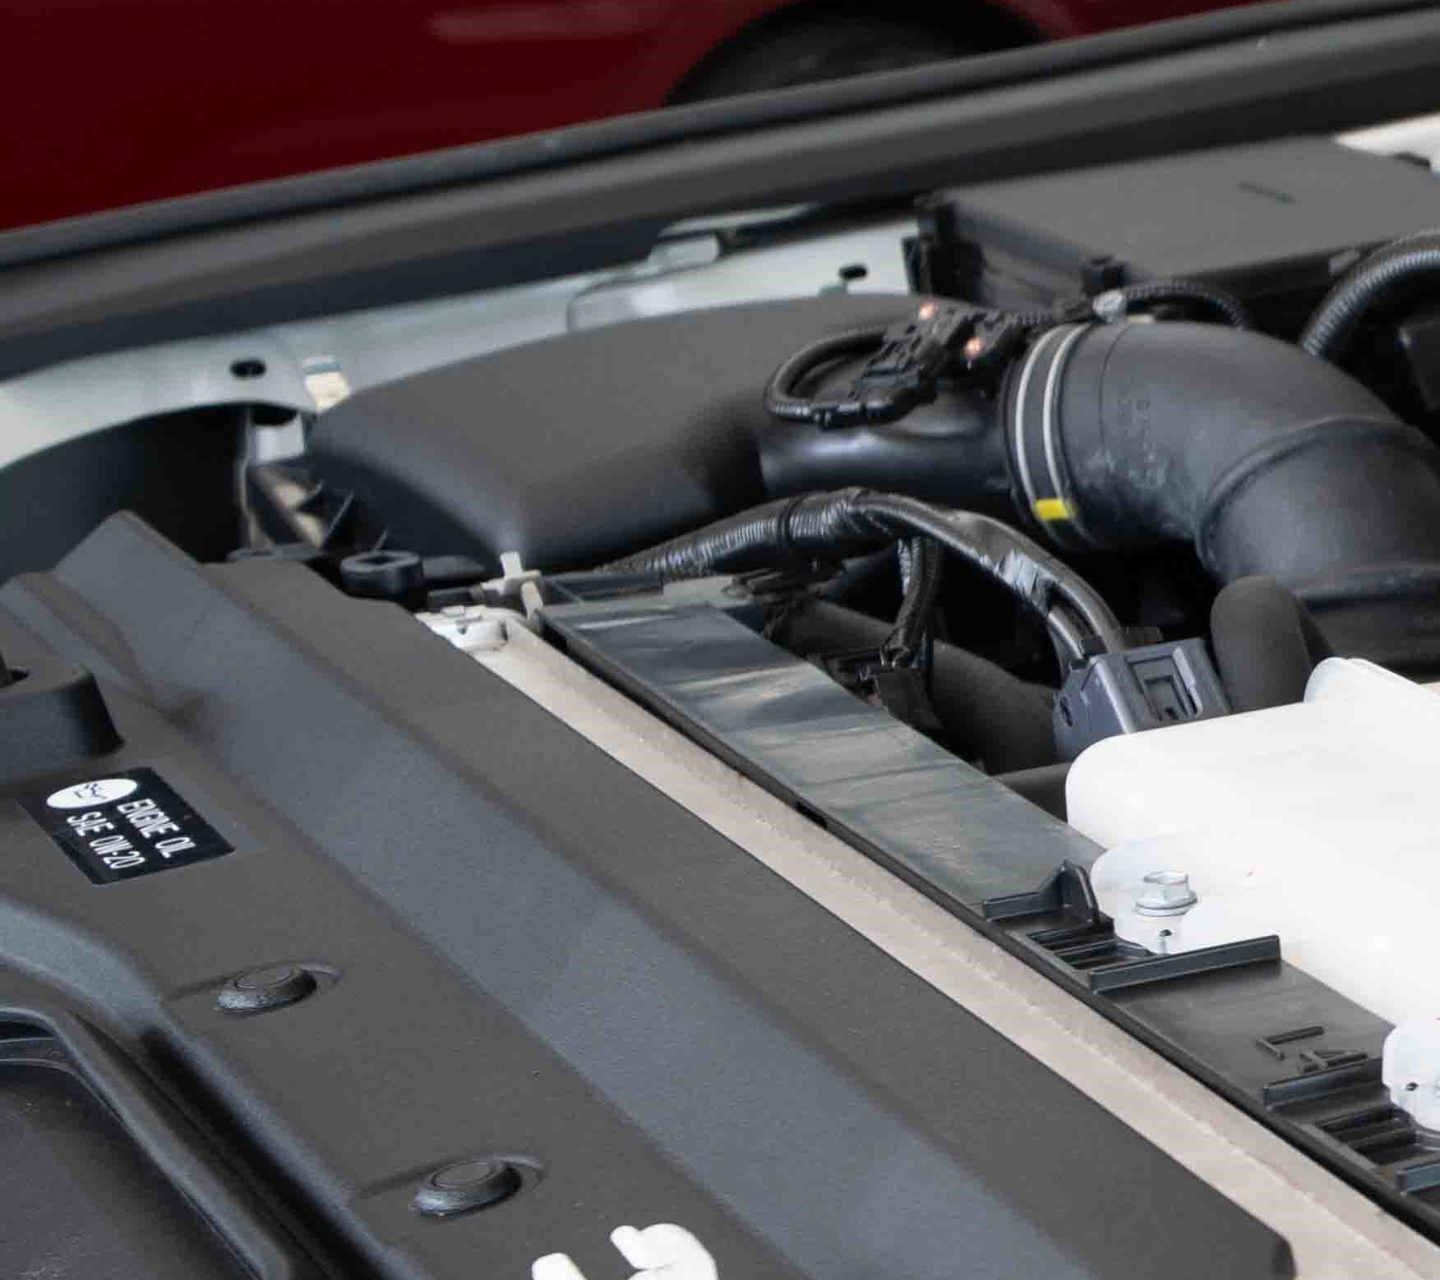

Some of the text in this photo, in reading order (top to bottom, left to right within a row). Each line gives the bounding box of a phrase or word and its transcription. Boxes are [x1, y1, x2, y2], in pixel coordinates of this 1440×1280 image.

[66, 811, 146, 870] SAE 0W-20
[116, 798, 196, 858] ENGINE OIL
